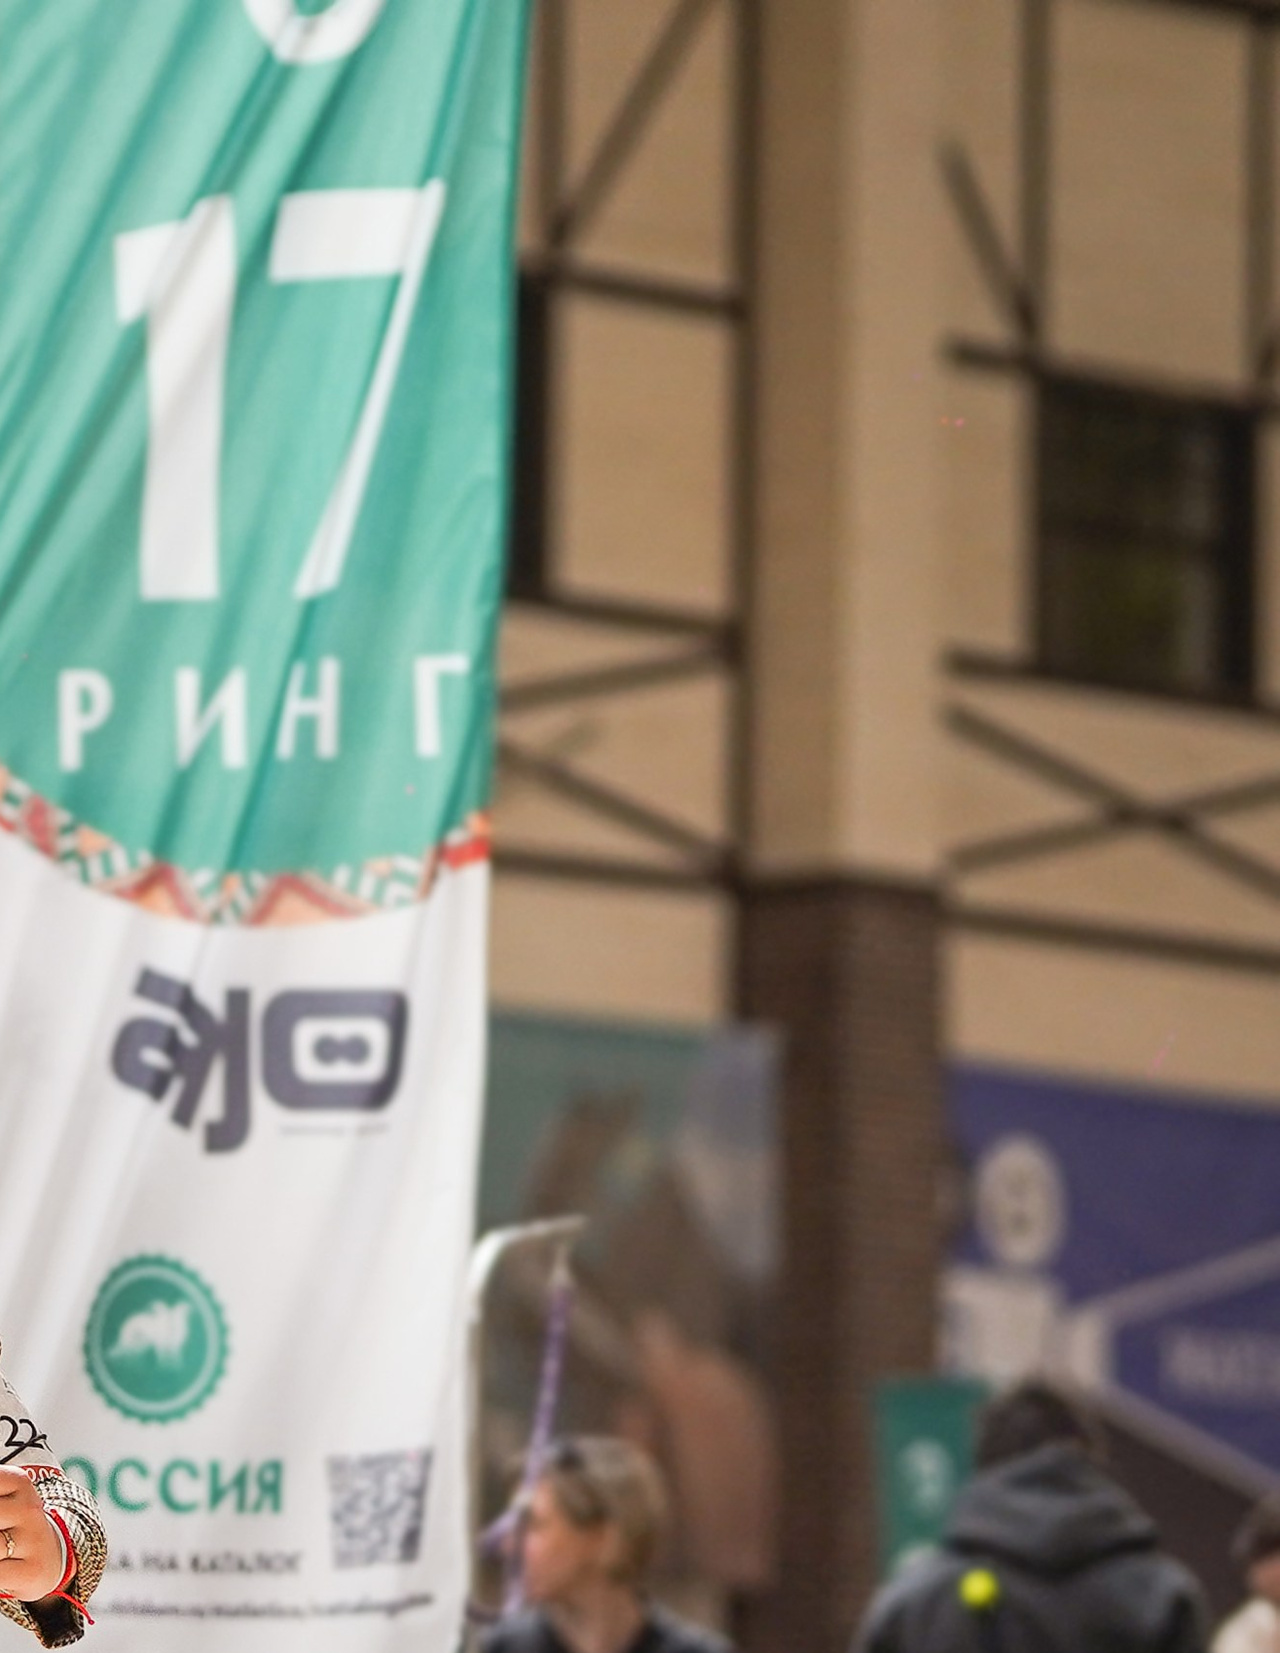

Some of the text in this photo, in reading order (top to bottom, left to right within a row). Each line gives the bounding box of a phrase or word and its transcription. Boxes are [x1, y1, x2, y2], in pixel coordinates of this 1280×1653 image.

[114, 178, 447, 602] 17
[58, 654, 470, 772] РИНГ
[0, 1415, 54, 1453] 22
[61, 1456, 284, 1515] ОССИЯ
